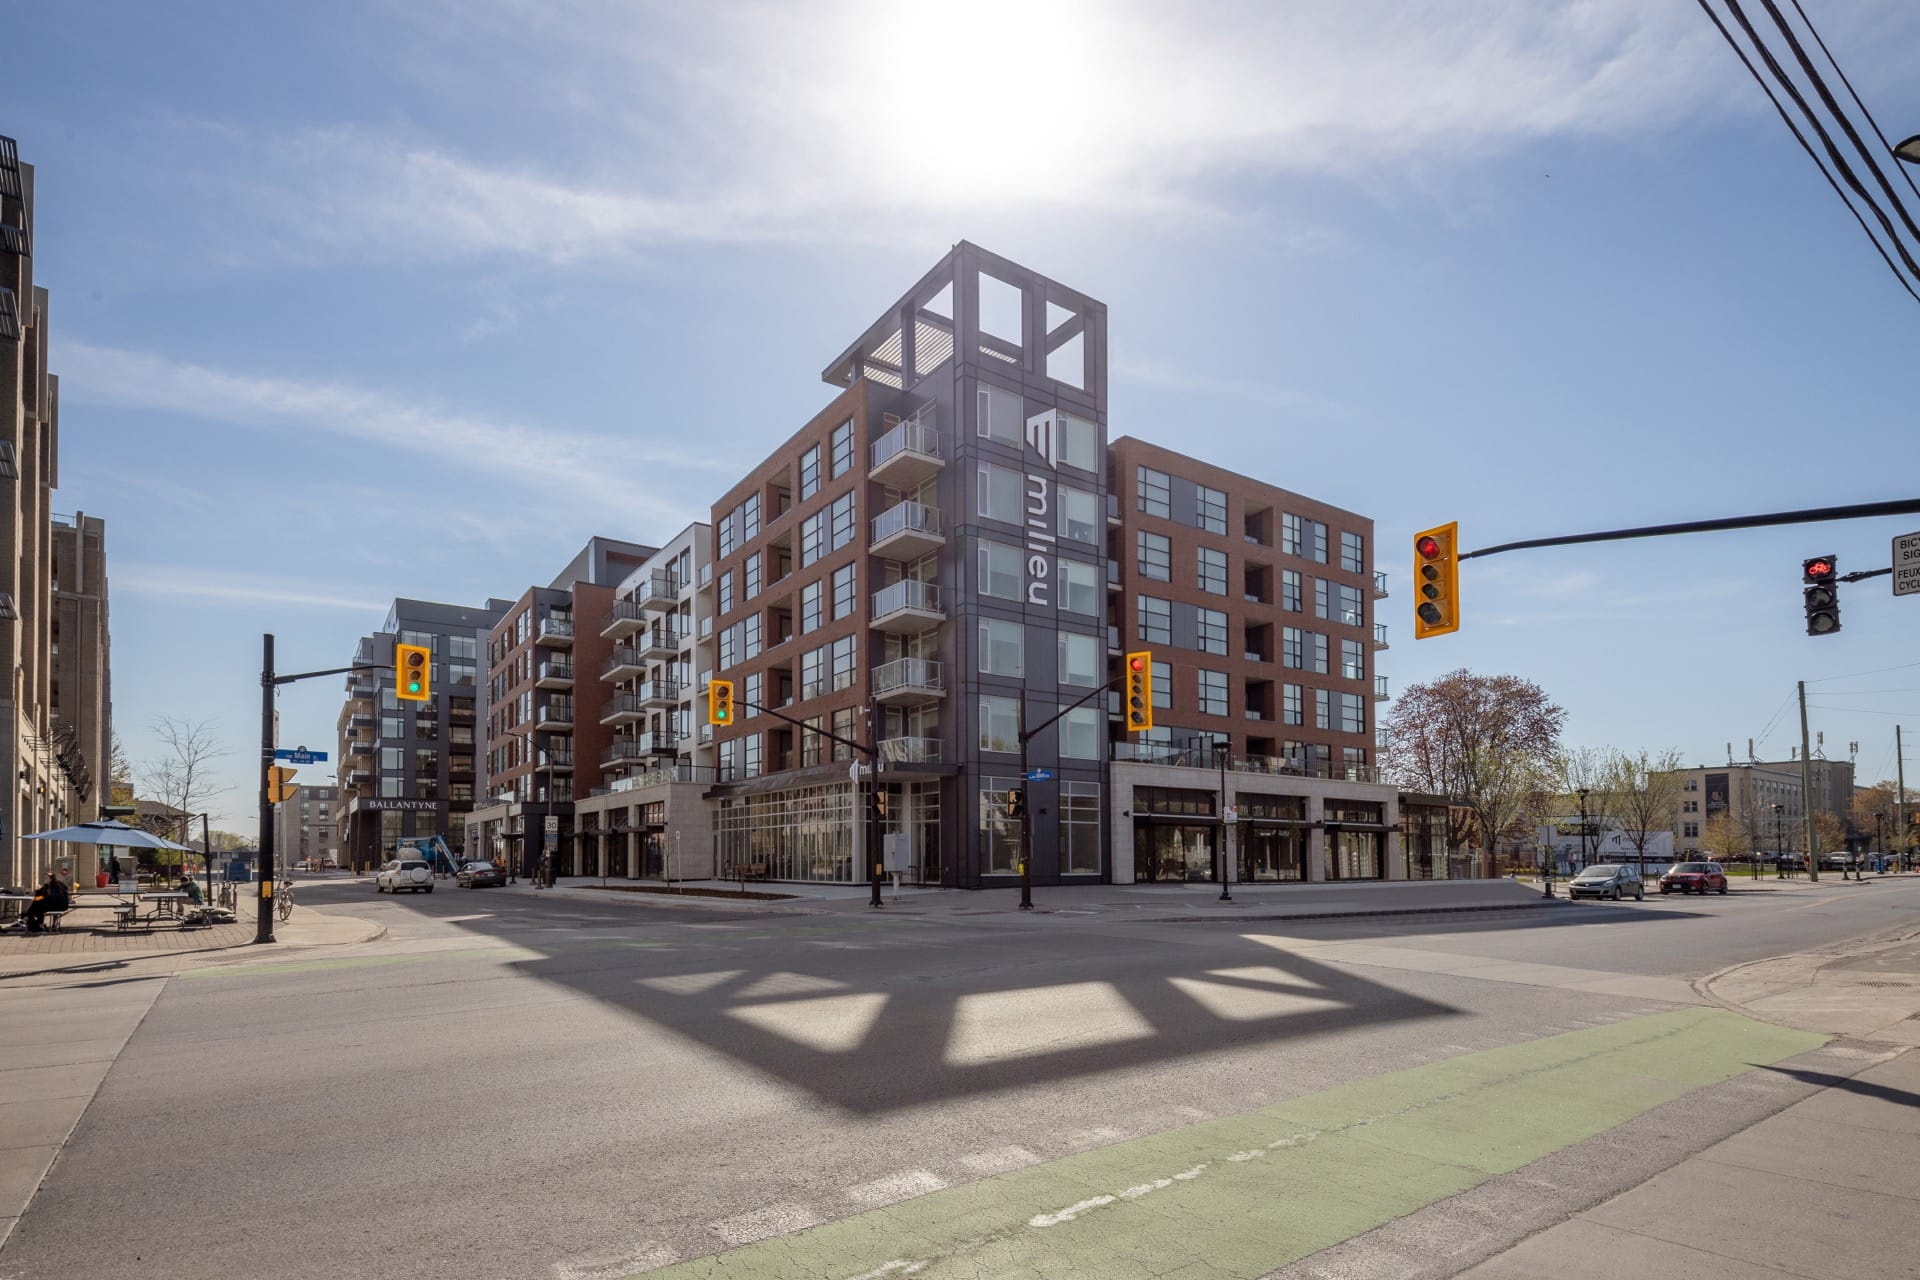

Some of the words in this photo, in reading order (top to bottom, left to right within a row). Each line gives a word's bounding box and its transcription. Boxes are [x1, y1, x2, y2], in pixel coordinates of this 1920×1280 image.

[1027, 474, 1056, 606] milieu
[1900, 537, 1920, 549] BIC
[294, 752, 311, 760] Main
[369, 800, 438, 810] BALLANTYNE
